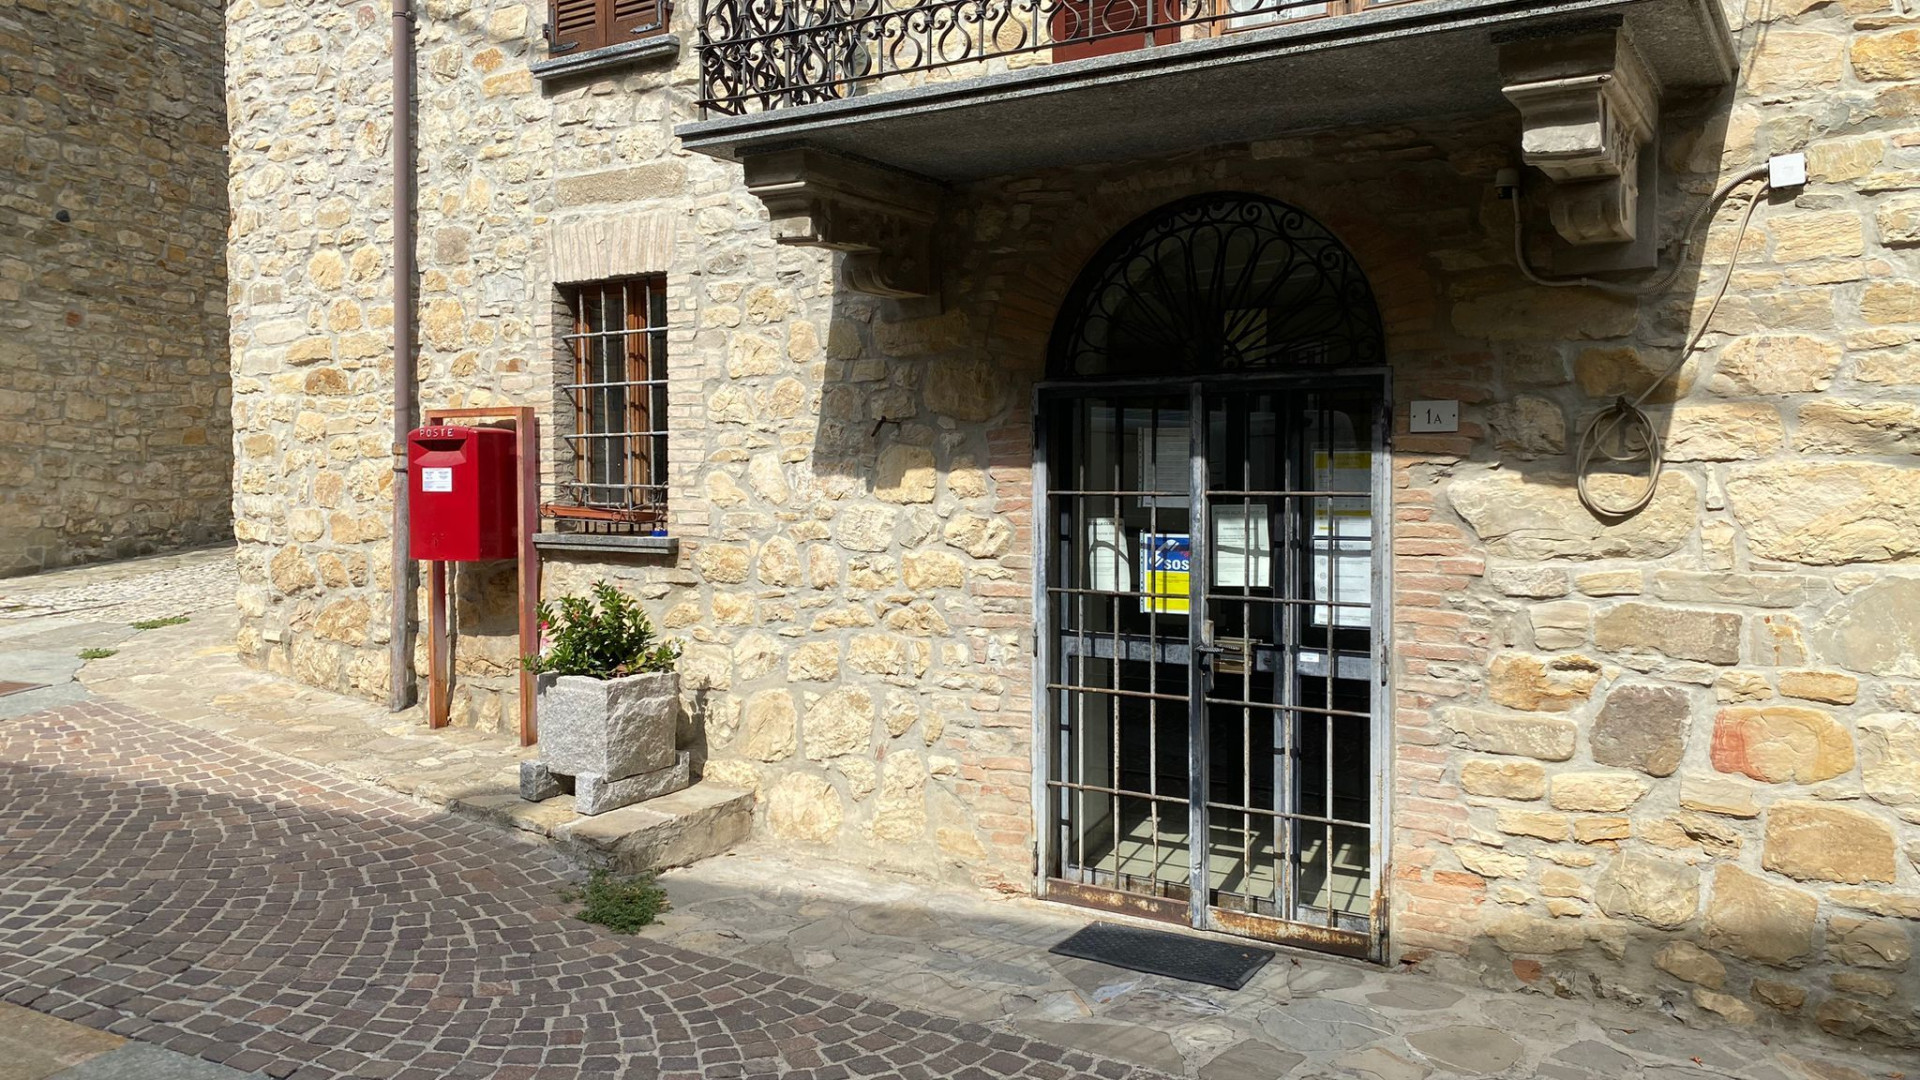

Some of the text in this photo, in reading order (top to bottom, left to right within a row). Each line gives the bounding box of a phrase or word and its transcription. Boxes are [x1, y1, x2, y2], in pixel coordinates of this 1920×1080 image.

[1426, 408, 1442, 424] 1A
[420, 428, 454, 437] POSTE
[1164, 559, 1190, 570] SOS
